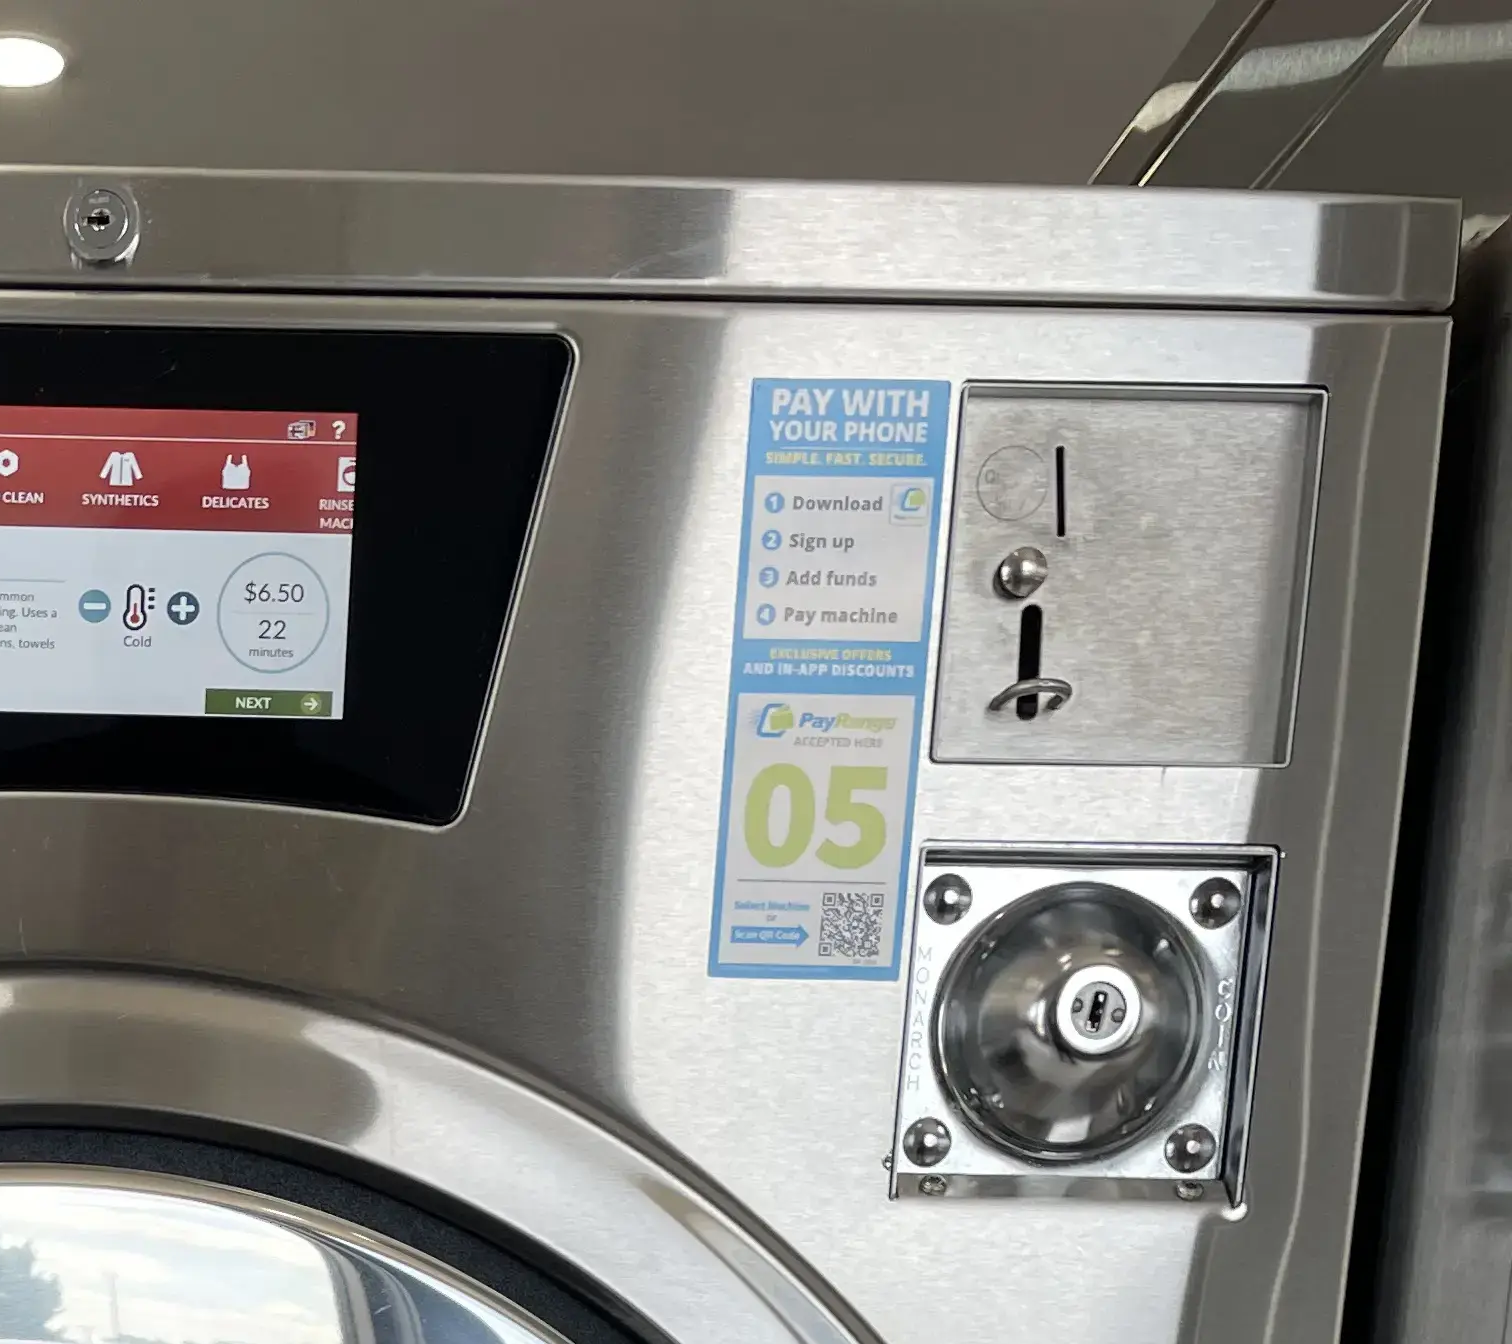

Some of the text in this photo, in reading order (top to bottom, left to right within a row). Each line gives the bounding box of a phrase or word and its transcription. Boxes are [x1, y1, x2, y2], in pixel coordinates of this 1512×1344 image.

[772, 388, 930, 417] PAY WITH
[332, 420, 346, 440] ?
[769, 420, 928, 443] YOUR PHONE
[869, 453, 927, 466] SECURE.
[2, 491, 44, 504] CLEAN
[82, 493, 159, 508] SYNTHETICS
[202, 496, 269, 510] DELICATES
[792, 495, 883, 511] Download
[789, 533, 826, 552] Sign
[832, 536, 854, 552] up
[786, 571, 821, 586] Add
[827, 571, 877, 587] funds
[245, 580, 304, 604] $6.50
[21, 607, 48, 618] Uses
[51, 610, 57, 618] a
[784, 607, 816, 626] Pay
[821, 608, 898, 624] machine
[258, 620, 286, 640] 22
[18, 637, 55, 649] towels
[123, 635, 152, 648] Cold
[248, 647, 294, 658] minutes
[743, 662, 914, 678] AND IN-APP DISCOUNTS
[235, 697, 272, 709] NEXT
[794, 737, 883, 748] ACCEPTED HERE
[744, 763, 887, 870] 05
